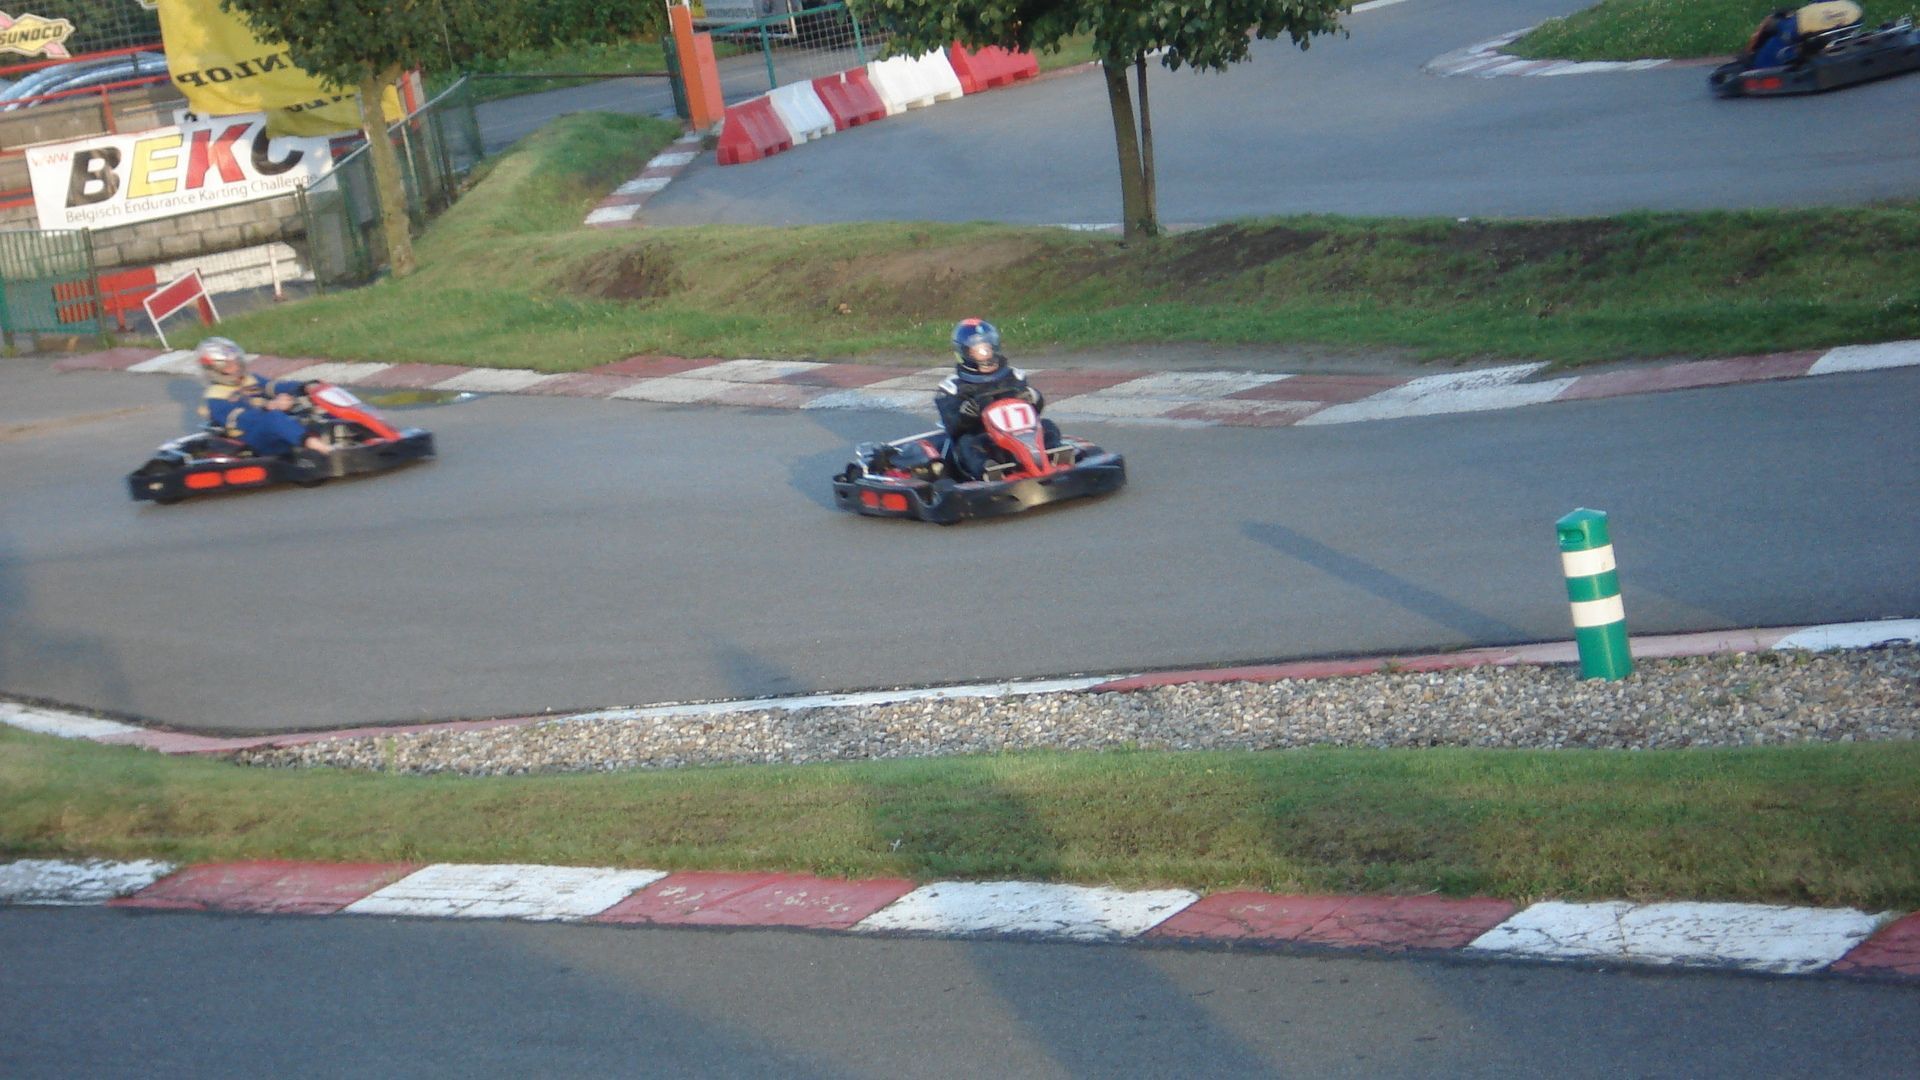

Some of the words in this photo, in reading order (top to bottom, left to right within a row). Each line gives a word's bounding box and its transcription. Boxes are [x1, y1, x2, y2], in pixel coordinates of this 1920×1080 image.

[0, 25, 62, 44] SUNOCO
[65, 204, 121, 223] Belgisch
[125, 194, 196, 213] Endurance
[199, 184, 248, 201] Karting
[251, 175, 316, 194] Challenge
[1001, 407, 1029, 428] 17
